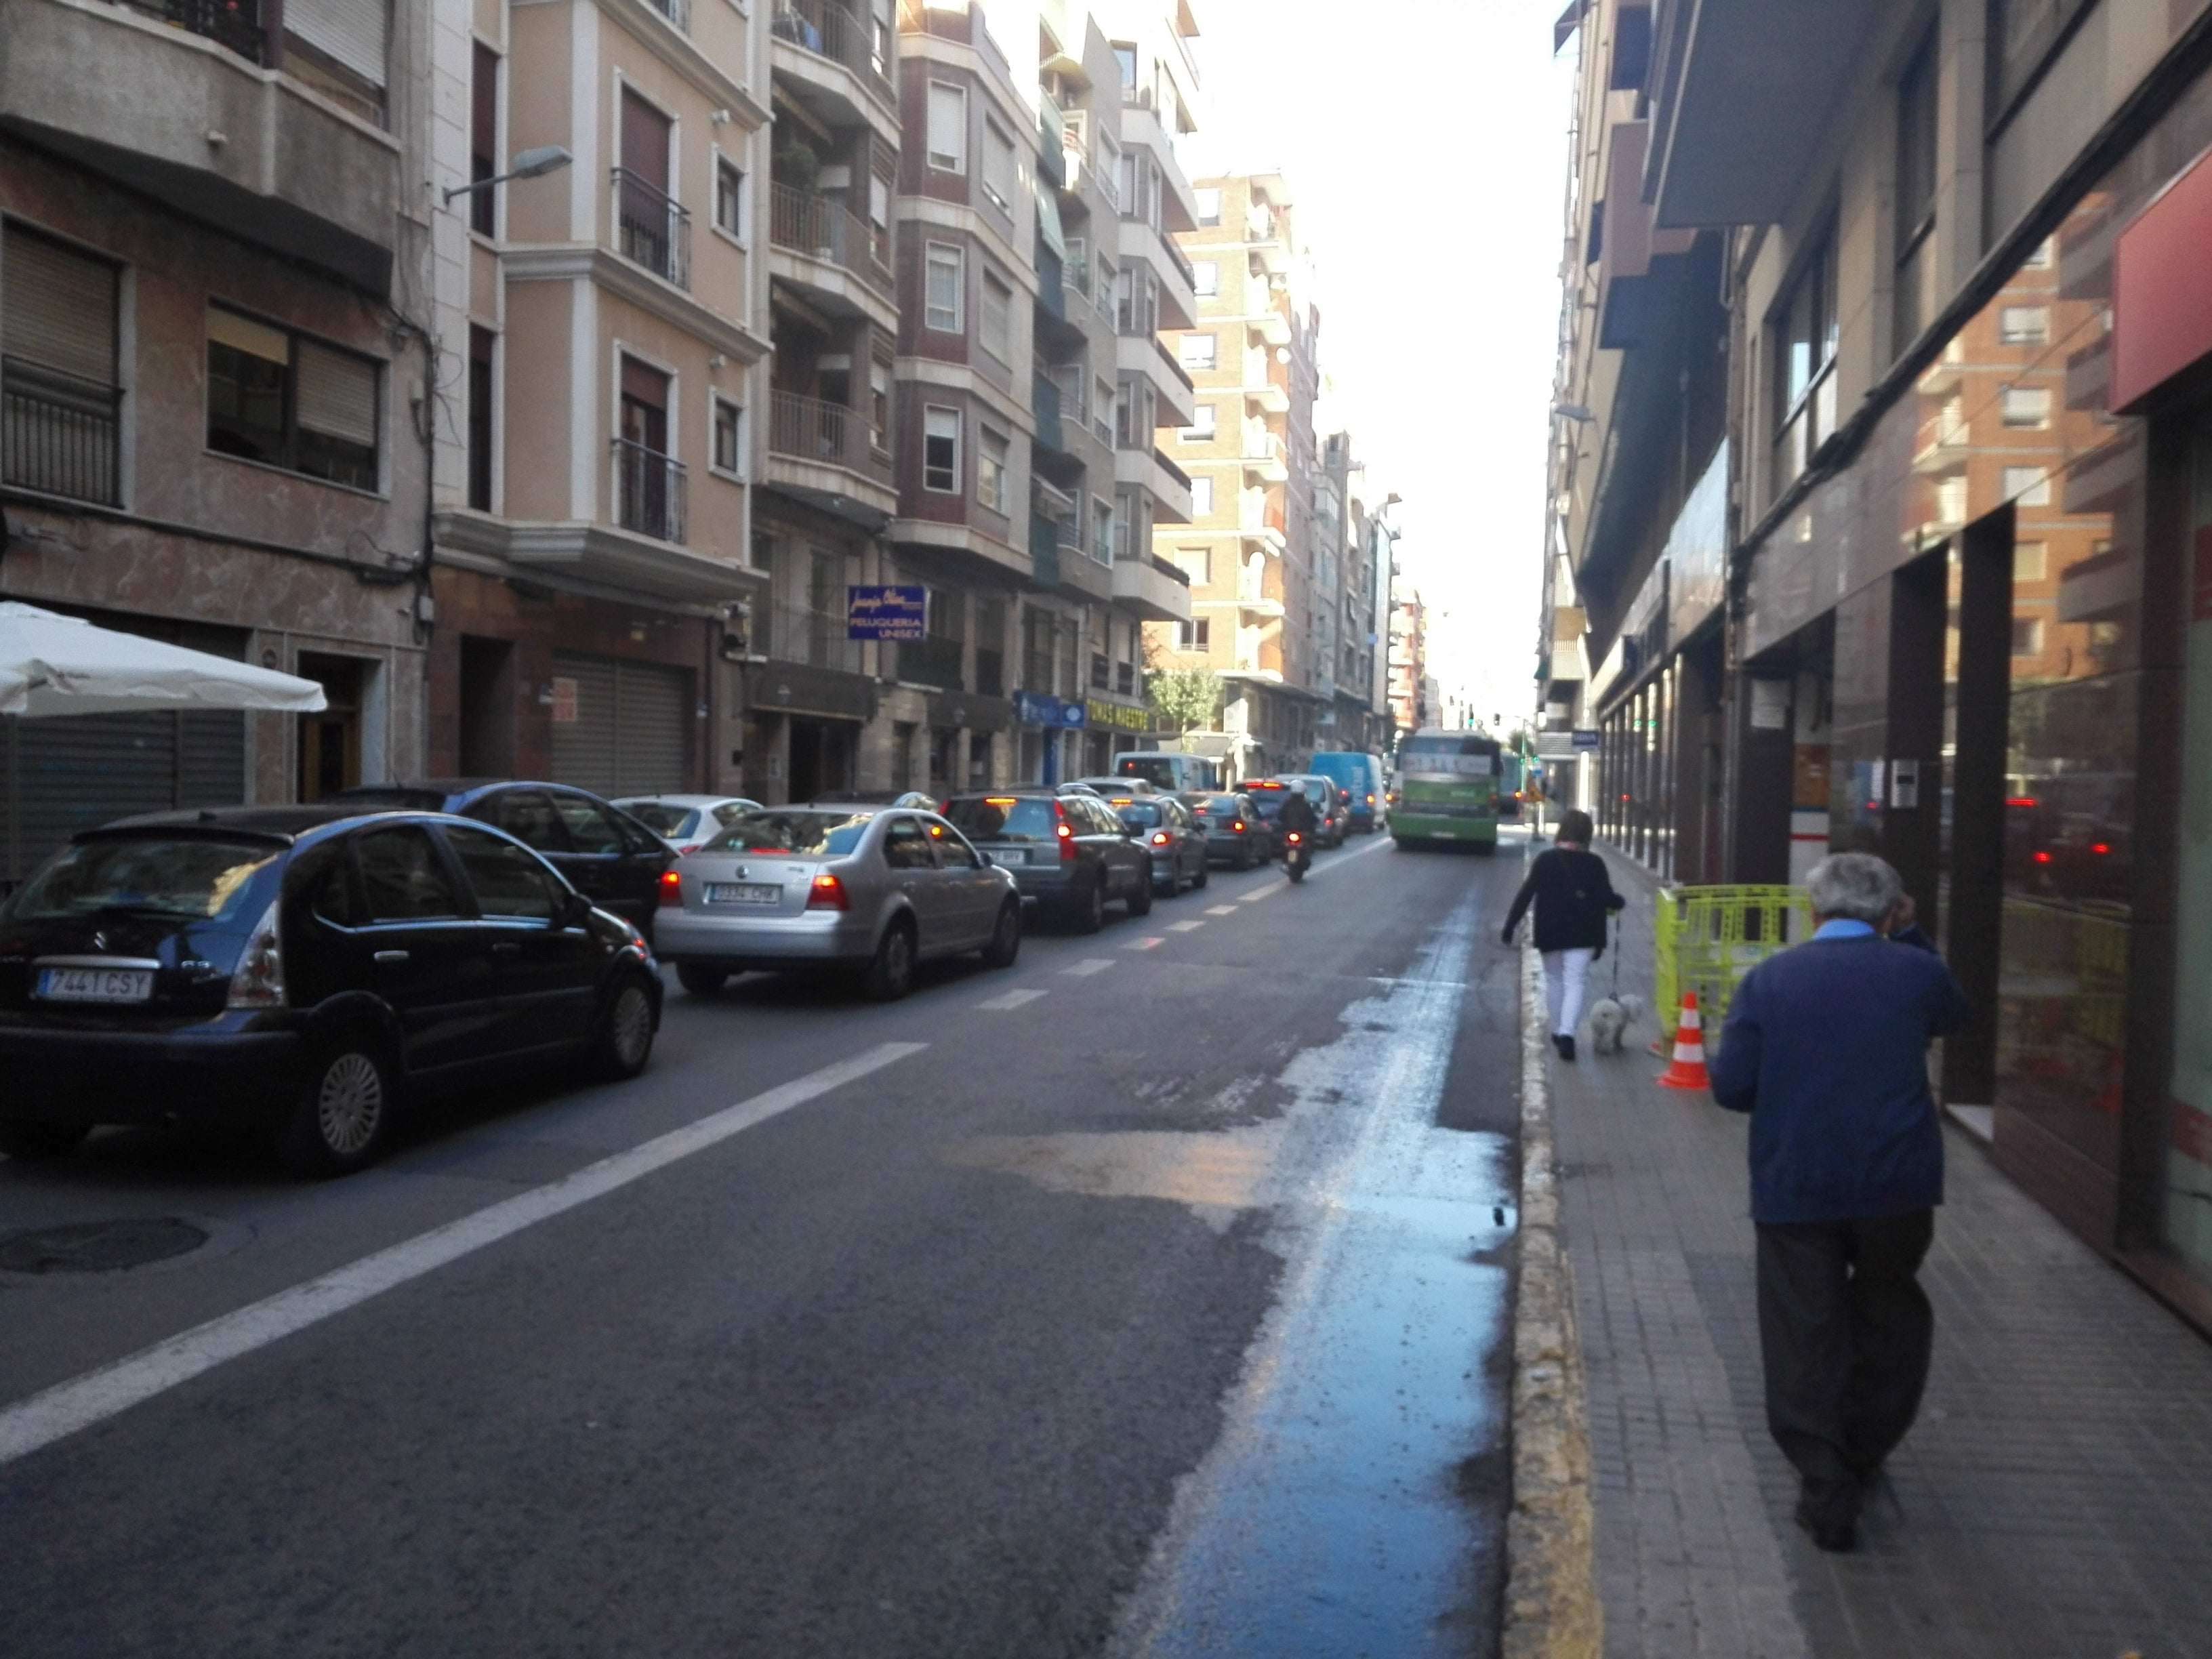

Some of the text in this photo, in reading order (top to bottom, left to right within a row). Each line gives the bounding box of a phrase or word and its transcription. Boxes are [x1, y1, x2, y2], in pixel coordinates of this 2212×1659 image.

[850, 617, 921, 627] PELUQUERIA
[879, 629, 920, 638] UNISEX
[51, 971, 147, 994] 7441 CSY
